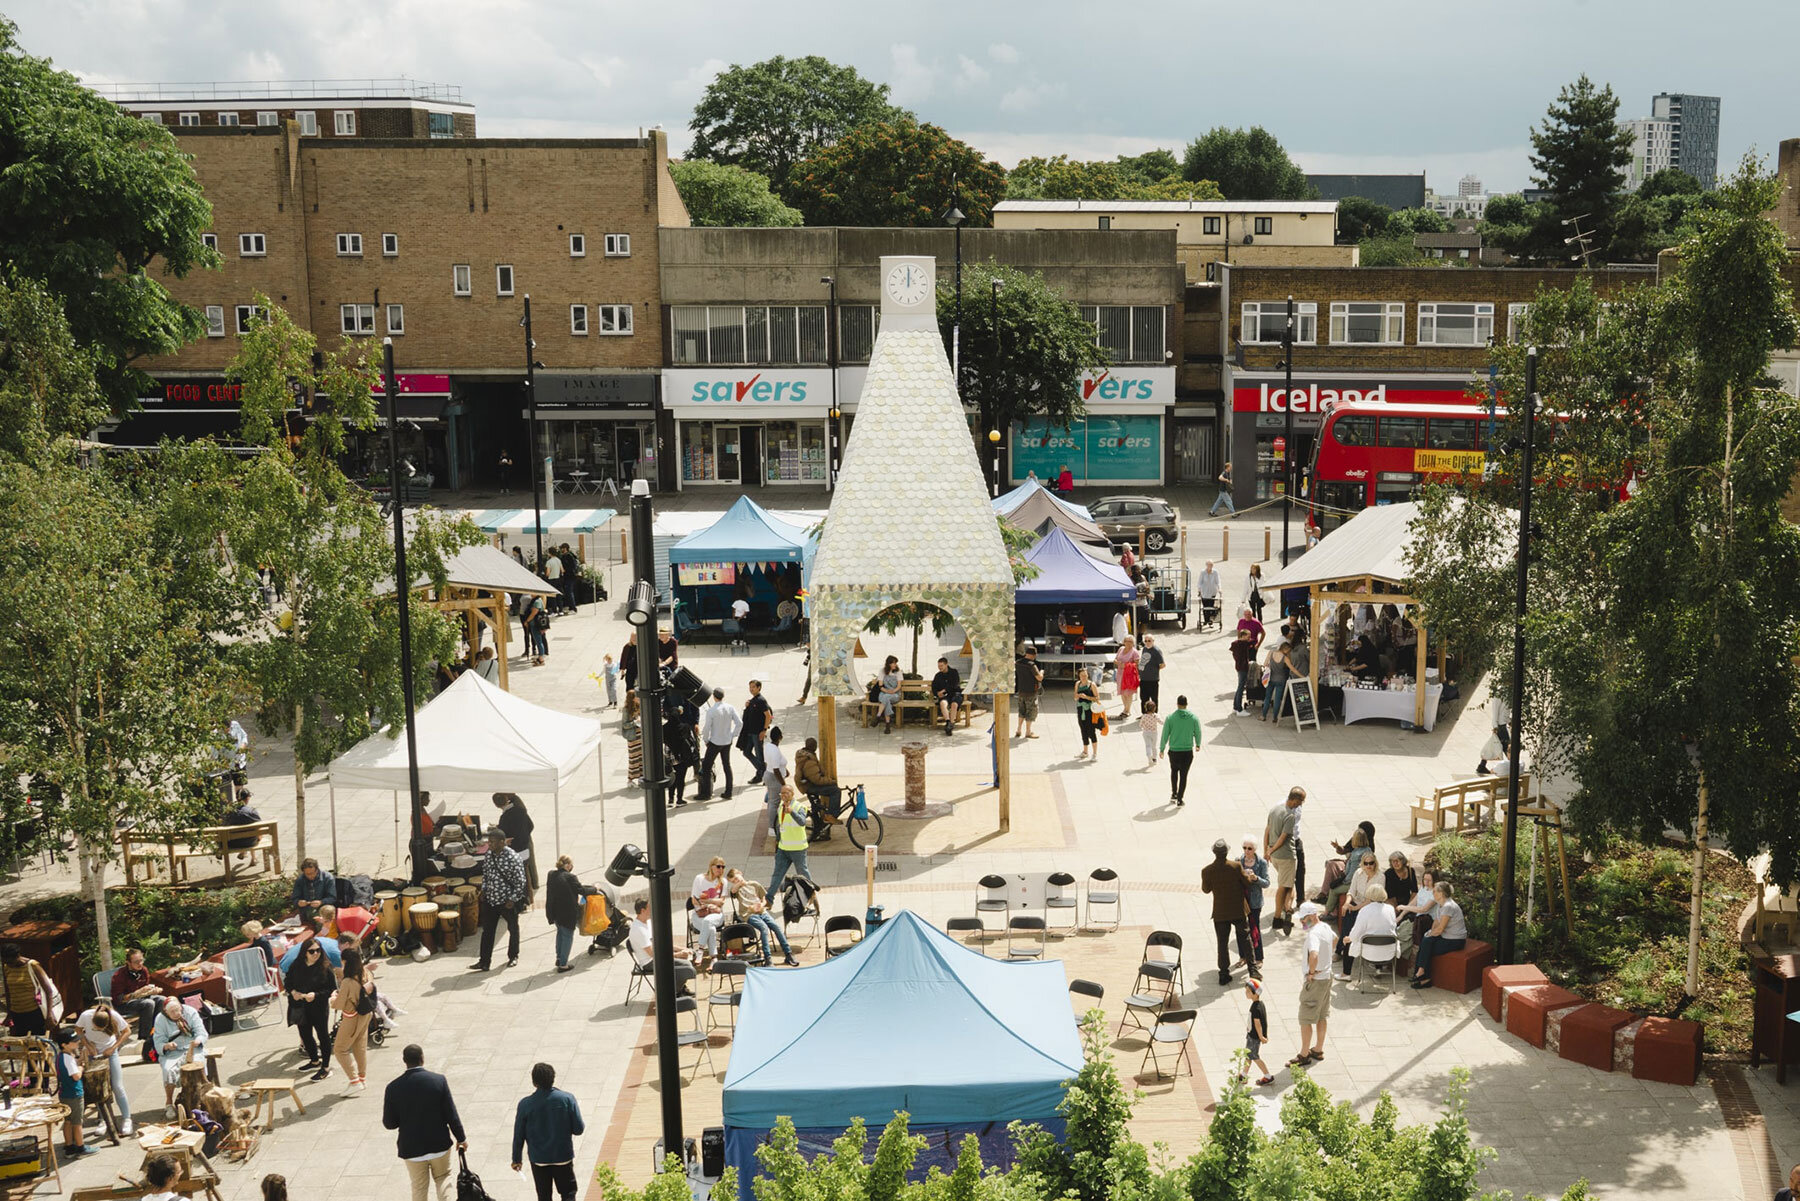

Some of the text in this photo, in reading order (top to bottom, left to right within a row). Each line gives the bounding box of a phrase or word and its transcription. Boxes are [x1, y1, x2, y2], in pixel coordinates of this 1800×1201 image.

[564, 379, 621, 389] IMAGE
[691, 373, 808, 402] savers
[1077, 370, 1153, 400] vers
[166, 384, 245, 401] FOOD CENT
[1260, 383, 1387, 413] Iceland
[1021, 434, 1075, 448] savers
[1098, 434, 1151, 448] savers
[1418, 454, 1482, 469] JOIN THE CIRCLE
